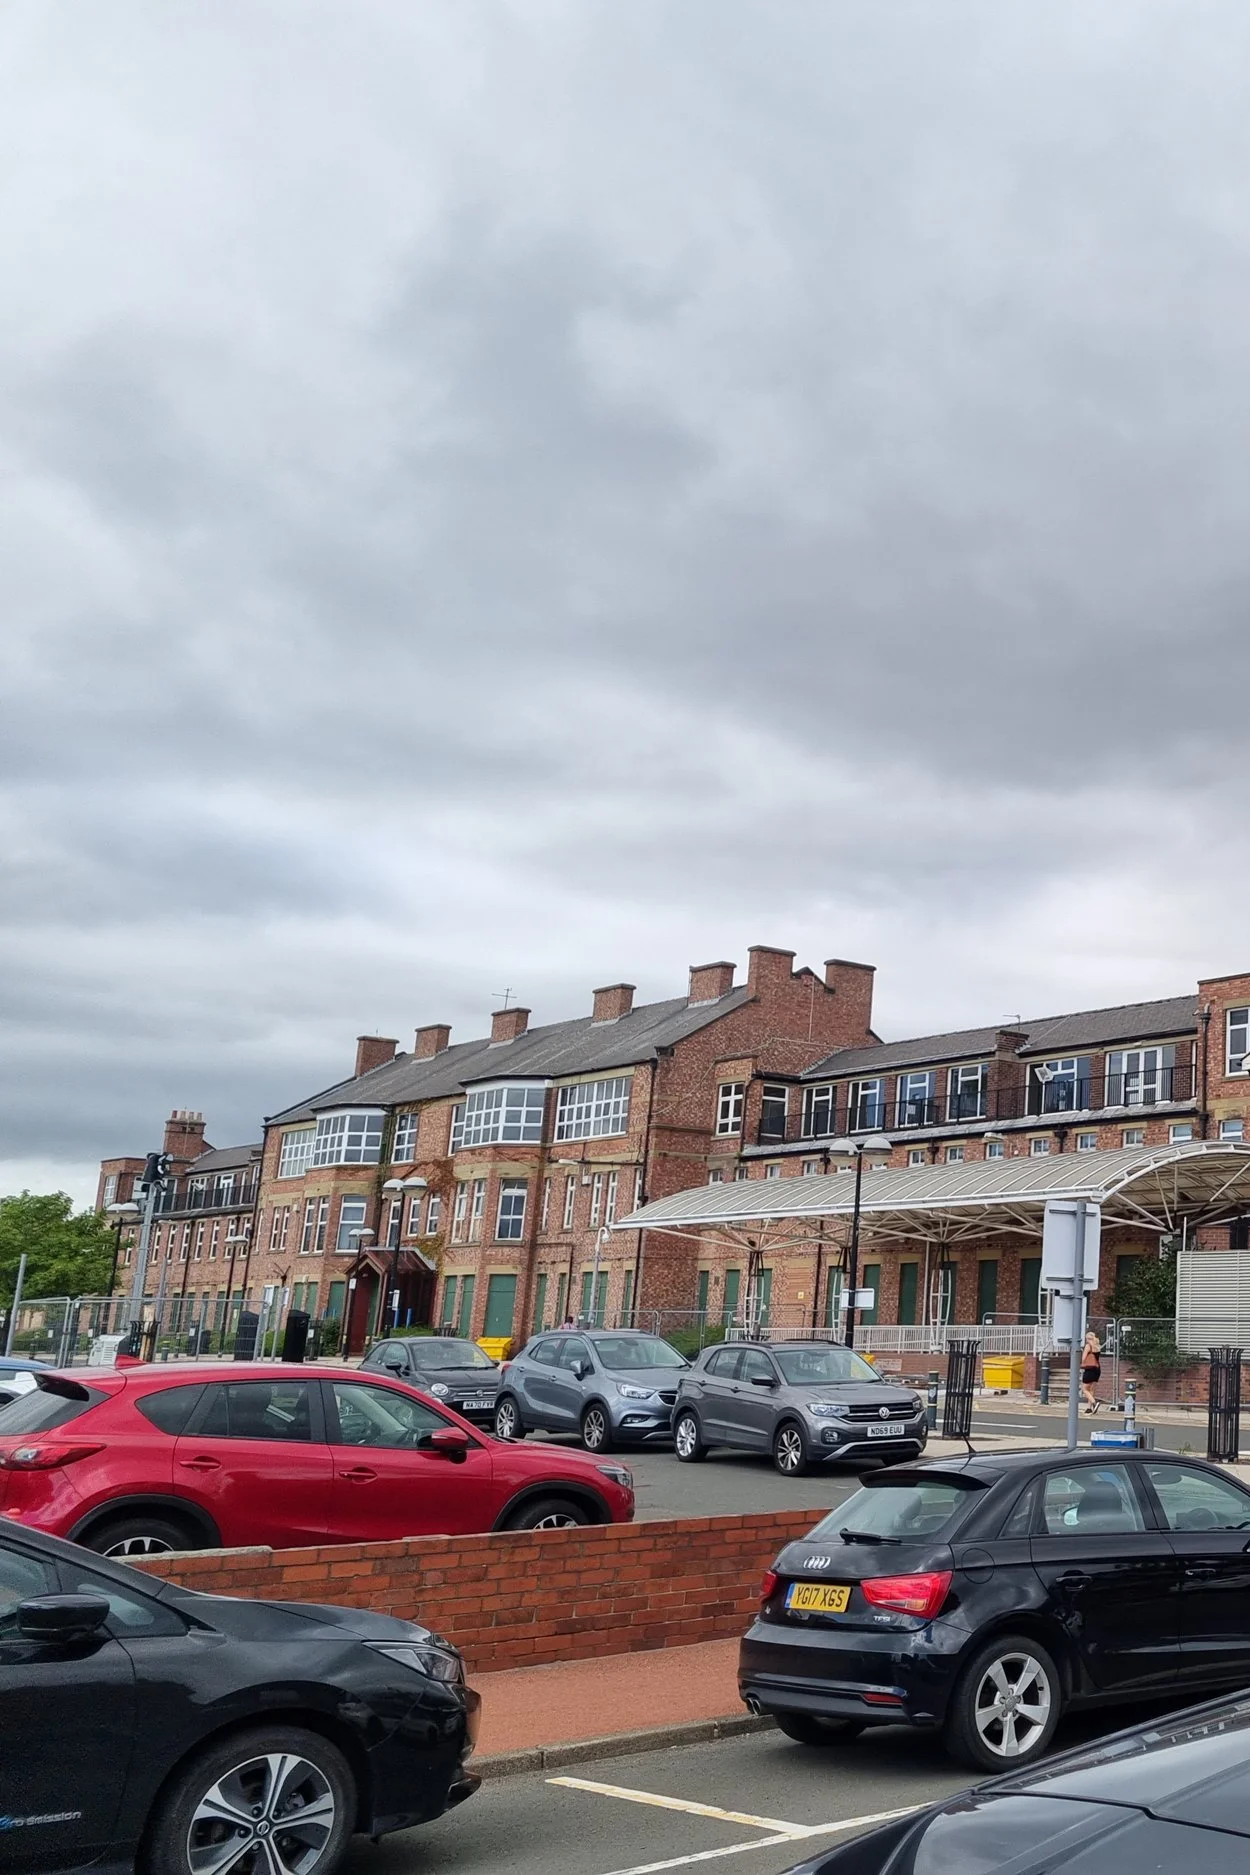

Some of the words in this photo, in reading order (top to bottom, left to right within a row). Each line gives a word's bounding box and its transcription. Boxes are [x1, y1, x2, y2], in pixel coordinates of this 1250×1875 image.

[870, 1427, 888, 1435] ND69
[796, 1586, 820, 1605] YG17
[819, 1587, 845, 1607] XGS
